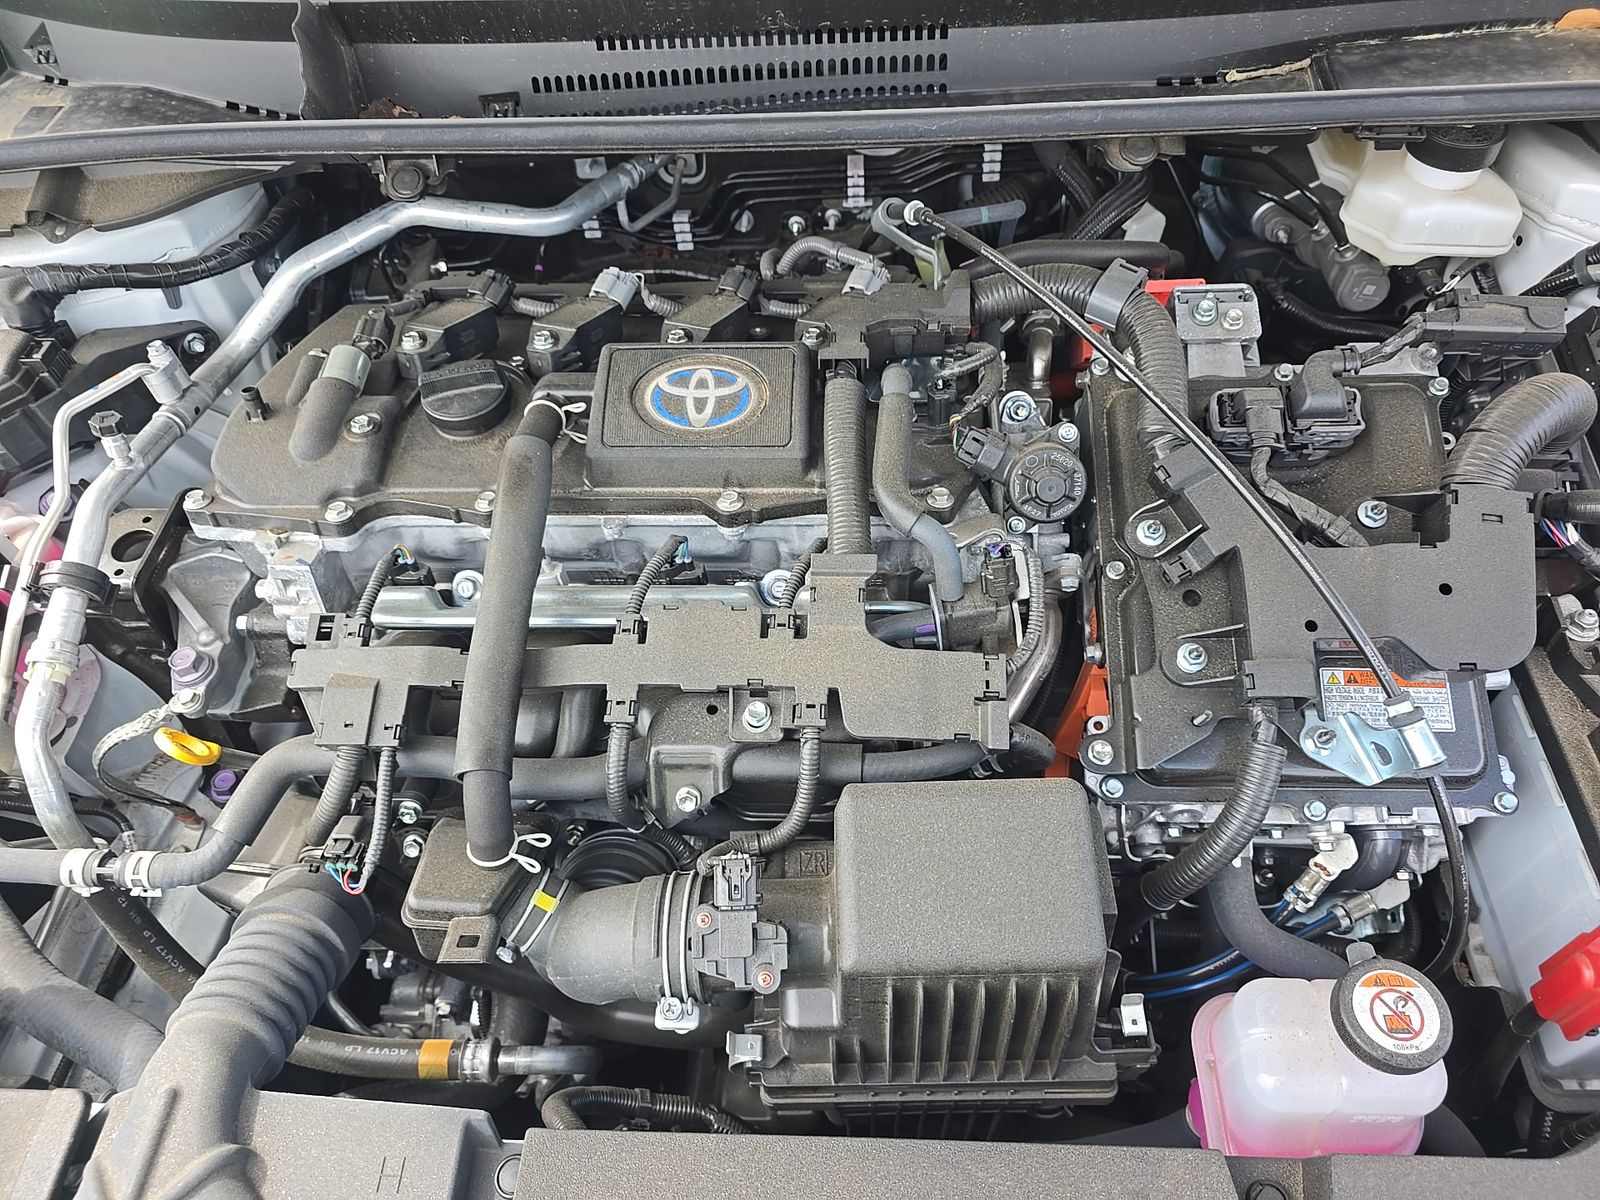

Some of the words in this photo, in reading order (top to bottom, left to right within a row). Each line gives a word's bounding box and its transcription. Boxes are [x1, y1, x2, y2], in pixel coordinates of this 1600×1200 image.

[1050, 452, 1074, 467] 25620
[1074, 473, 1082, 496] 37140
[1051, 503, 1075, 518] TOYOTA
[143, 930, 157, 943] LP
[155, 945, 187, 973] ACV17
[345, 1045, 362, 1053] LP
[366, 1046, 409, 1055] ACV17
[1392, 1043, 1420, 1051] 108kPa
